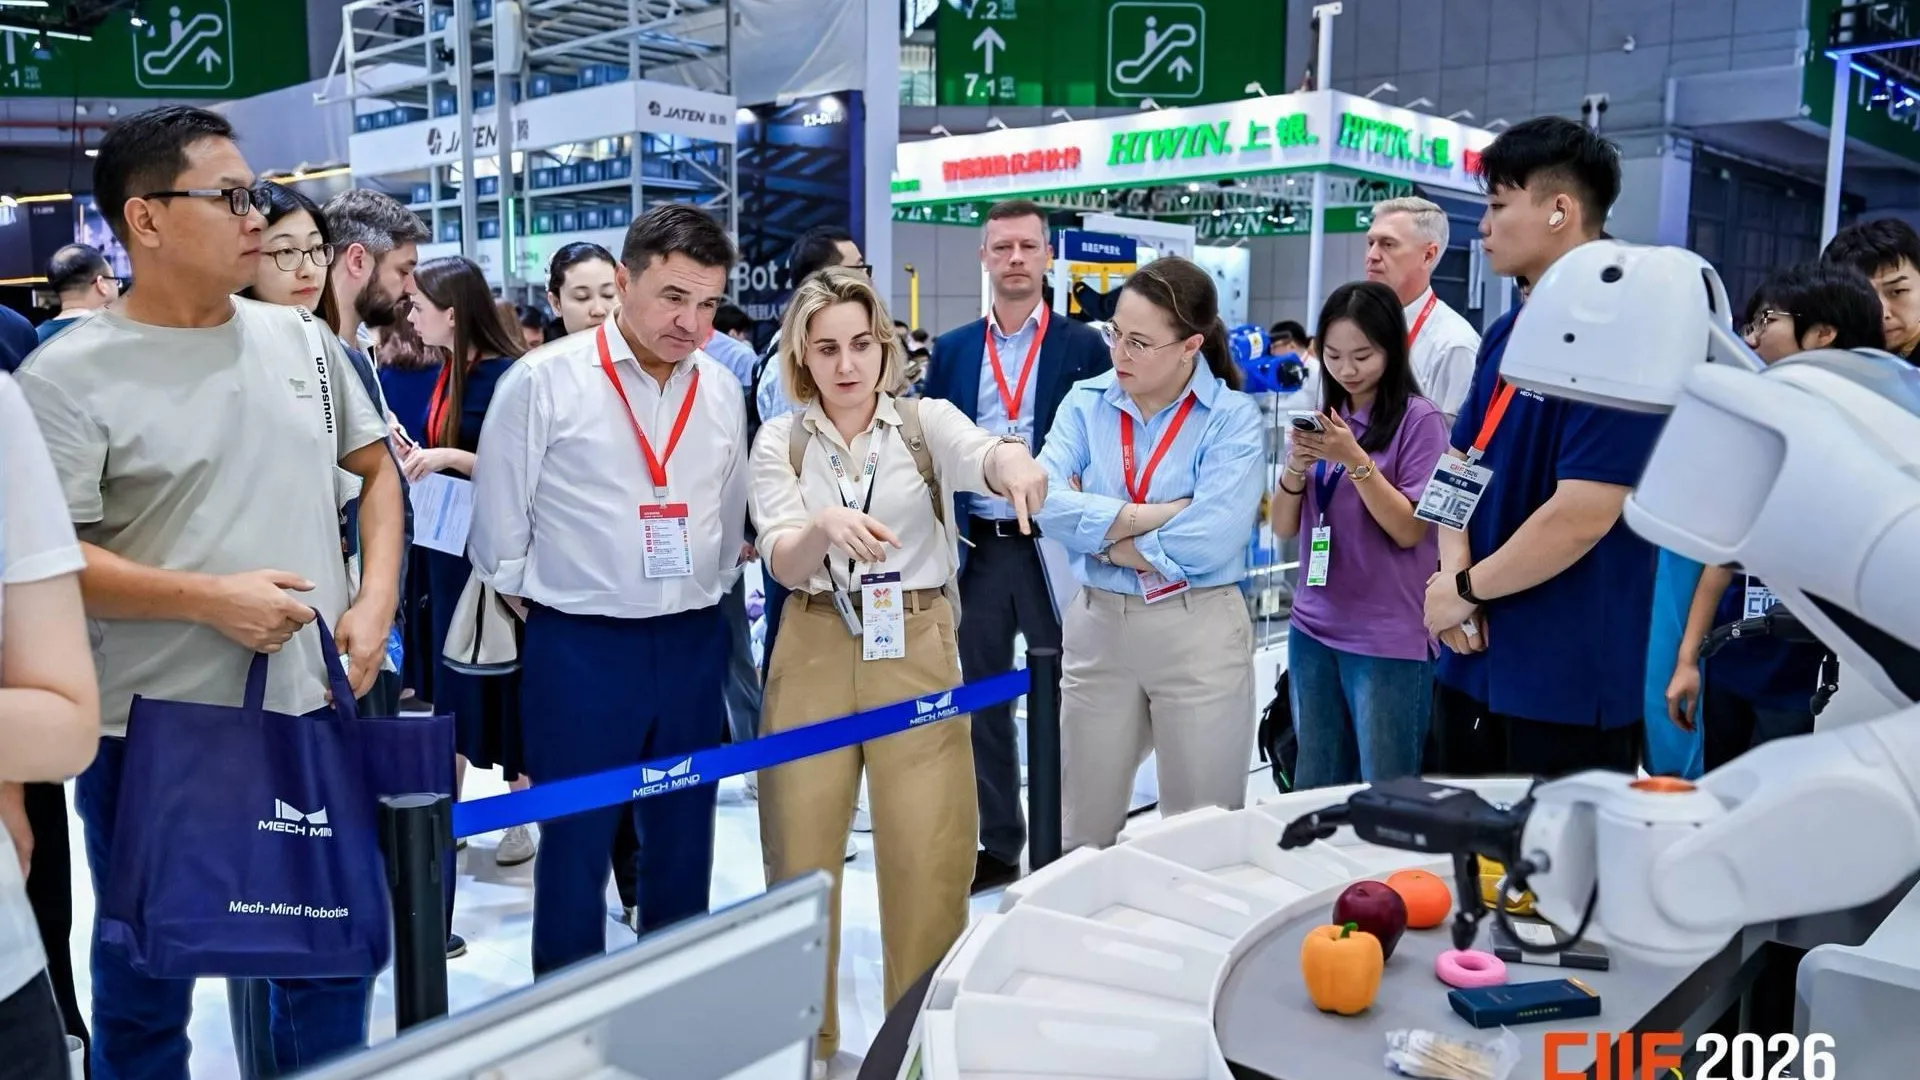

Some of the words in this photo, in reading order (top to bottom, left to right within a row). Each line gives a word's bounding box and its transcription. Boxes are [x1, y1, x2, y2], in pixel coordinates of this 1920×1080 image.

[964, 73, 996, 97] 7.1
[664, 107, 705, 122] JATEN
[909, 712, 937, 726] MECH
[632, 781, 669, 798] MECH
[671, 773, 701, 789] MIND
[258, 820, 306, 836] MECH
[228, 900, 302, 916] Mech-Mind
[304, 905, 349, 919] Robotics
